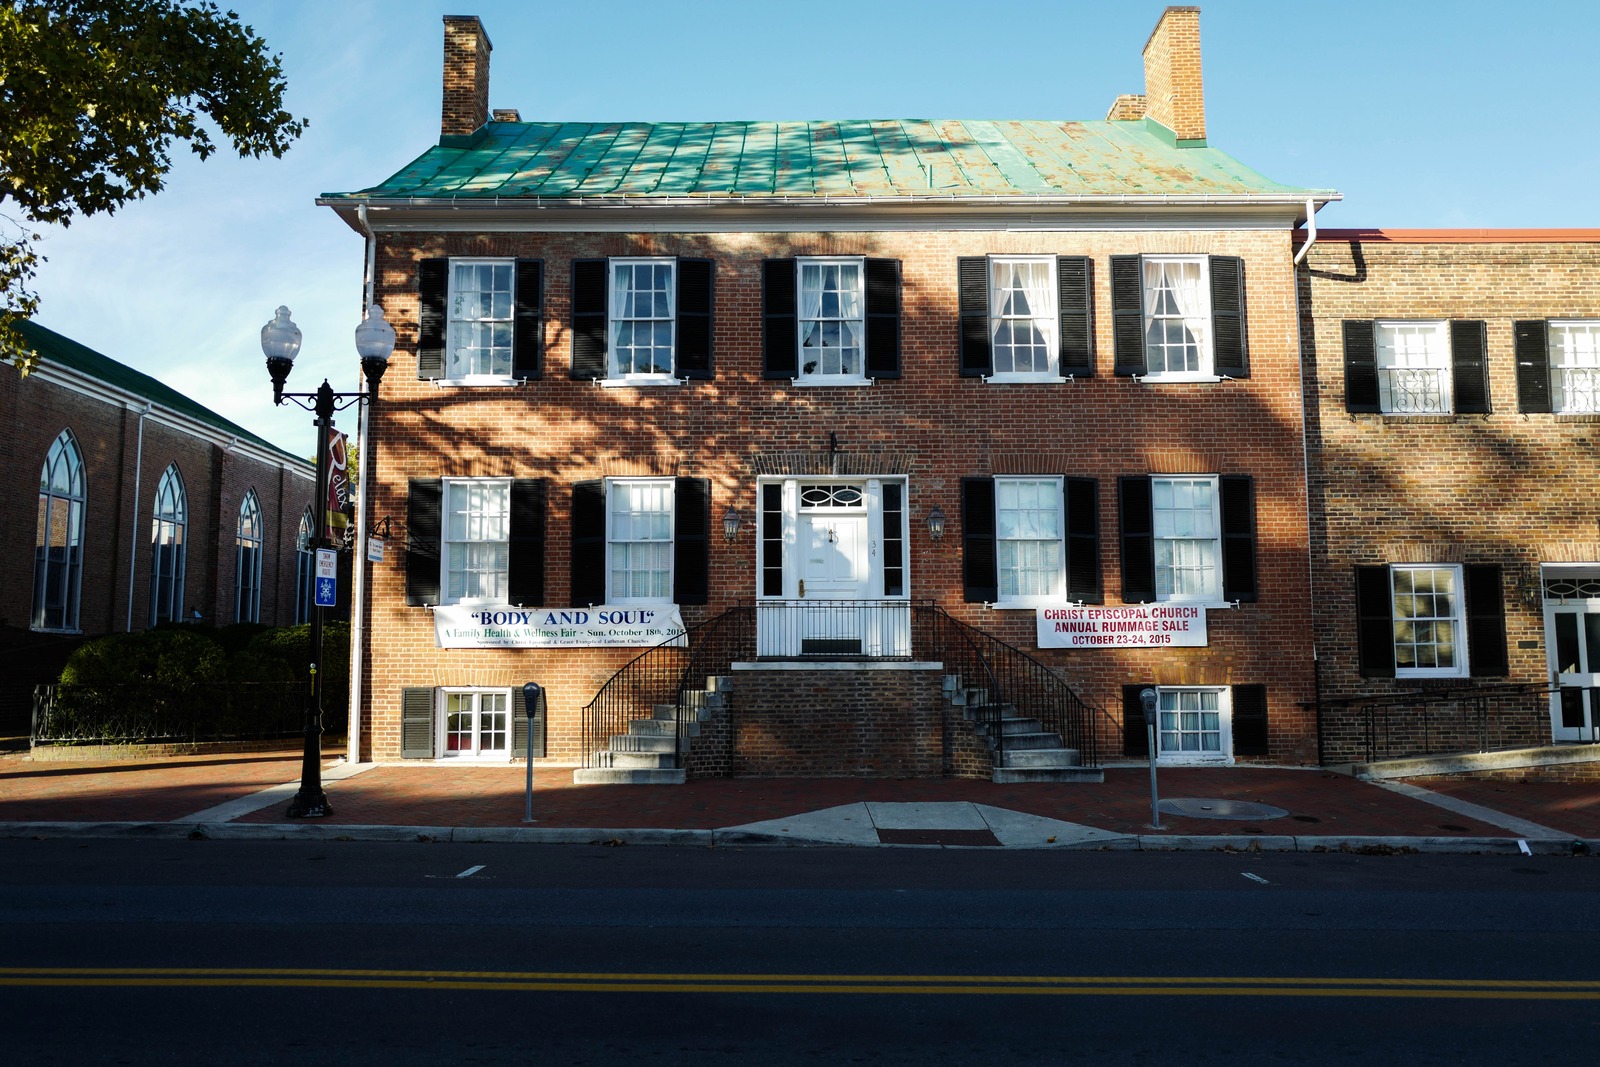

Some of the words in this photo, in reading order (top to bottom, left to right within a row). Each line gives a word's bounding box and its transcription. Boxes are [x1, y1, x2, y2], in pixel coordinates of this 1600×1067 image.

[327, 431, 348, 510] Relax
[544, 611, 589, 625] AND
[1044, 609, 1085, 620] CHRIST
[1088, 608, 1149, 620] EPISCOPAL
[1151, 607, 1198, 619] CHURCH
[1054, 621, 1098, 633] ANNUAL
[1102, 620, 1159, 633] RUMMAGE
[1162, 620, 1189, 631] SALE
[444, 629, 451, 638] A
[453, 628, 481, 639] Family
[484, 628, 512, 638] Health
[513, 629, 521, 638] &
[523, 628, 558, 638] Wellness
[560, 628, 577, 638] Fair
[587, 629, 607, 637] Sun.
[608, 628, 643, 637] October
[1072, 635, 1114, 645] OCTOBER
[1116, 635, 1147, 645] 23-24,
[1149, 634, 1171, 644] 2015
